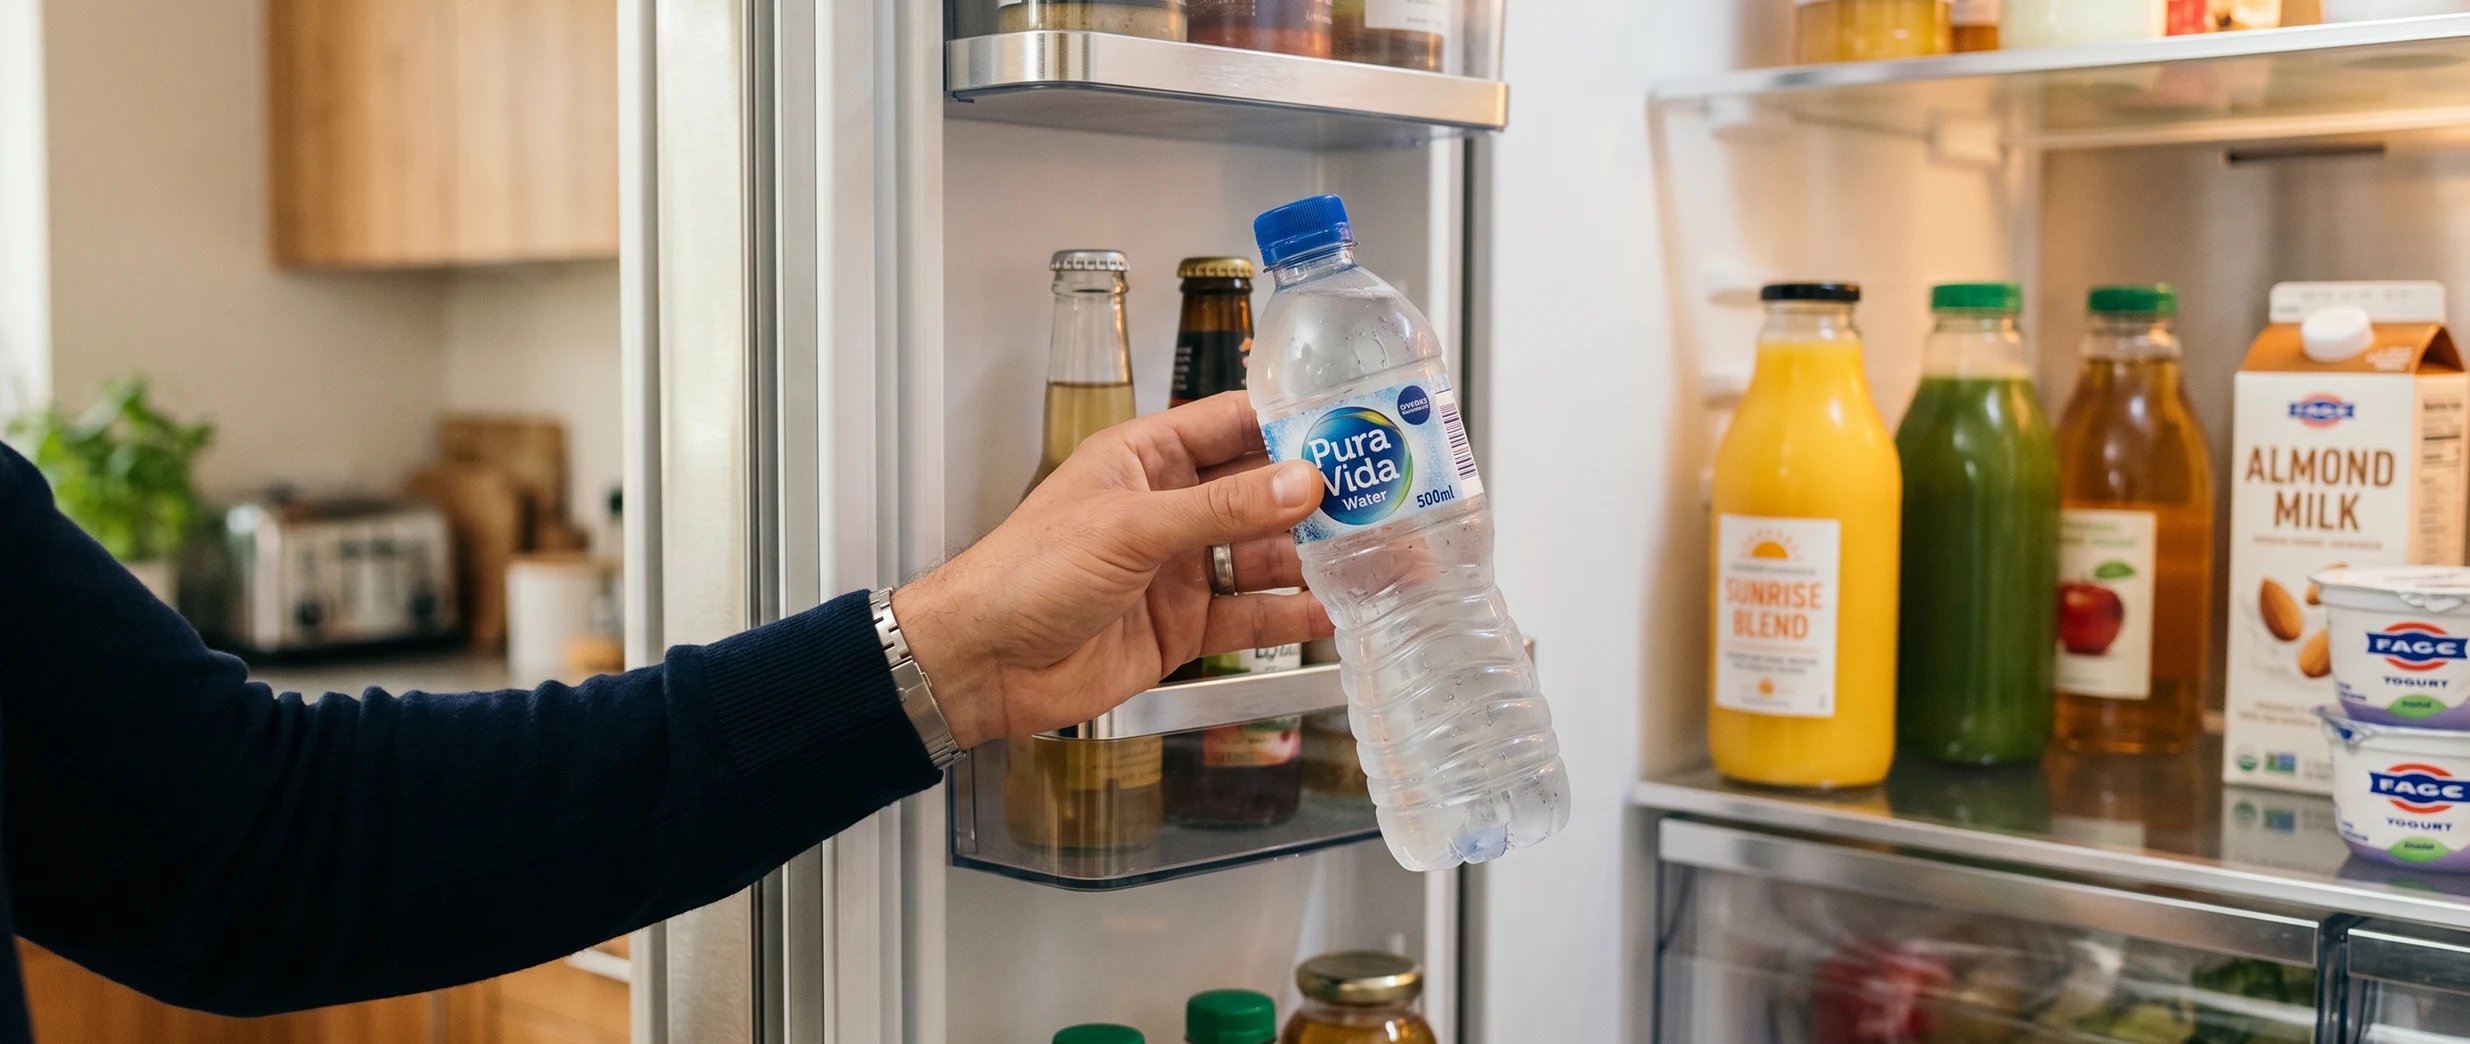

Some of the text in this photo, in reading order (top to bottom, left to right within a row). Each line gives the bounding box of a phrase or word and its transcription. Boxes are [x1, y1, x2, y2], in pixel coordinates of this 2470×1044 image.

[1308, 429, 1392, 469] Pura
[1320, 457, 1400, 497] Vida
[2246, 447, 2394, 487] ALMOND
[1342, 491, 1387, 511] Water
[1416, 485, 1455, 508] 500ml
[2275, 492, 2360, 530] MILK
[1726, 577, 1823, 611] SUNRISE
[1733, 609, 1809, 641] BLEND
[2384, 677, 2448, 688] YOGURT
[2388, 818, 2453, 831] YOGURT
